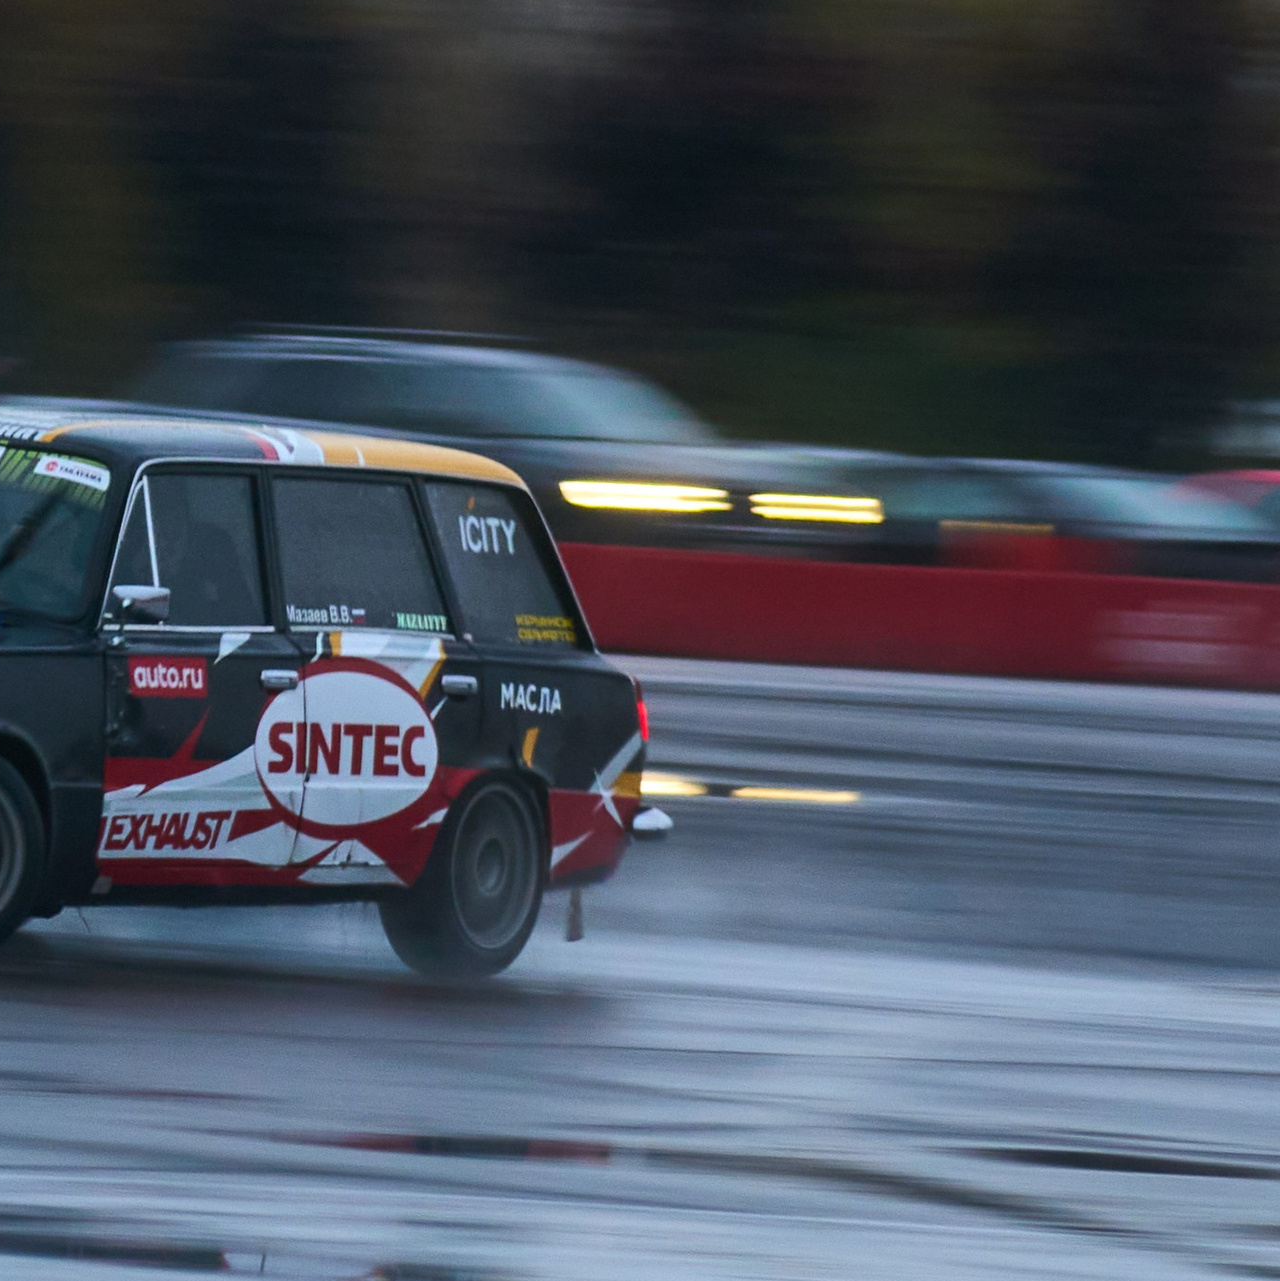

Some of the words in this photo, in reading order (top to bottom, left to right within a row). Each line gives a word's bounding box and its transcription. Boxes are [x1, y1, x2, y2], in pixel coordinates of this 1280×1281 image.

[458, 515, 516, 556] ICITY
[133, 663, 204, 690] auto.ru
[500, 682, 562, 715] МАСЛА
[267, 721, 426, 778] SINTEC
[103, 810, 233, 851] EXHAUST
